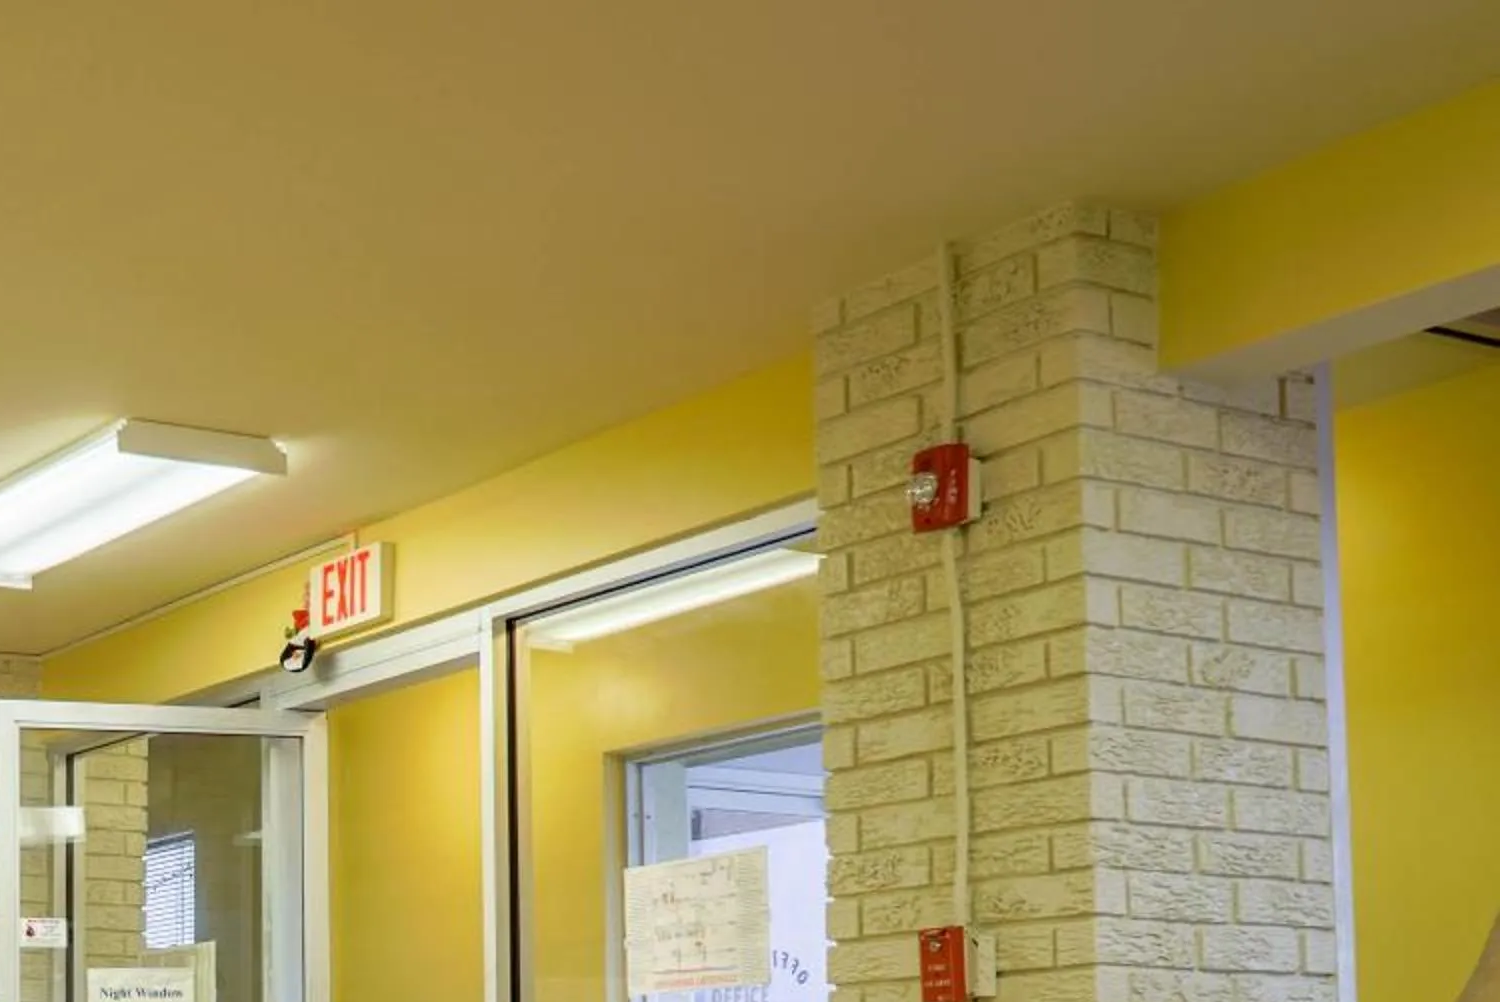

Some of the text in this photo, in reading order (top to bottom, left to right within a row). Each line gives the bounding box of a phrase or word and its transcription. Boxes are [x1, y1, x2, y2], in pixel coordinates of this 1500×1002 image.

[322, 550, 370, 626] EXIT
[100, 986, 184, 1001] Night Window
